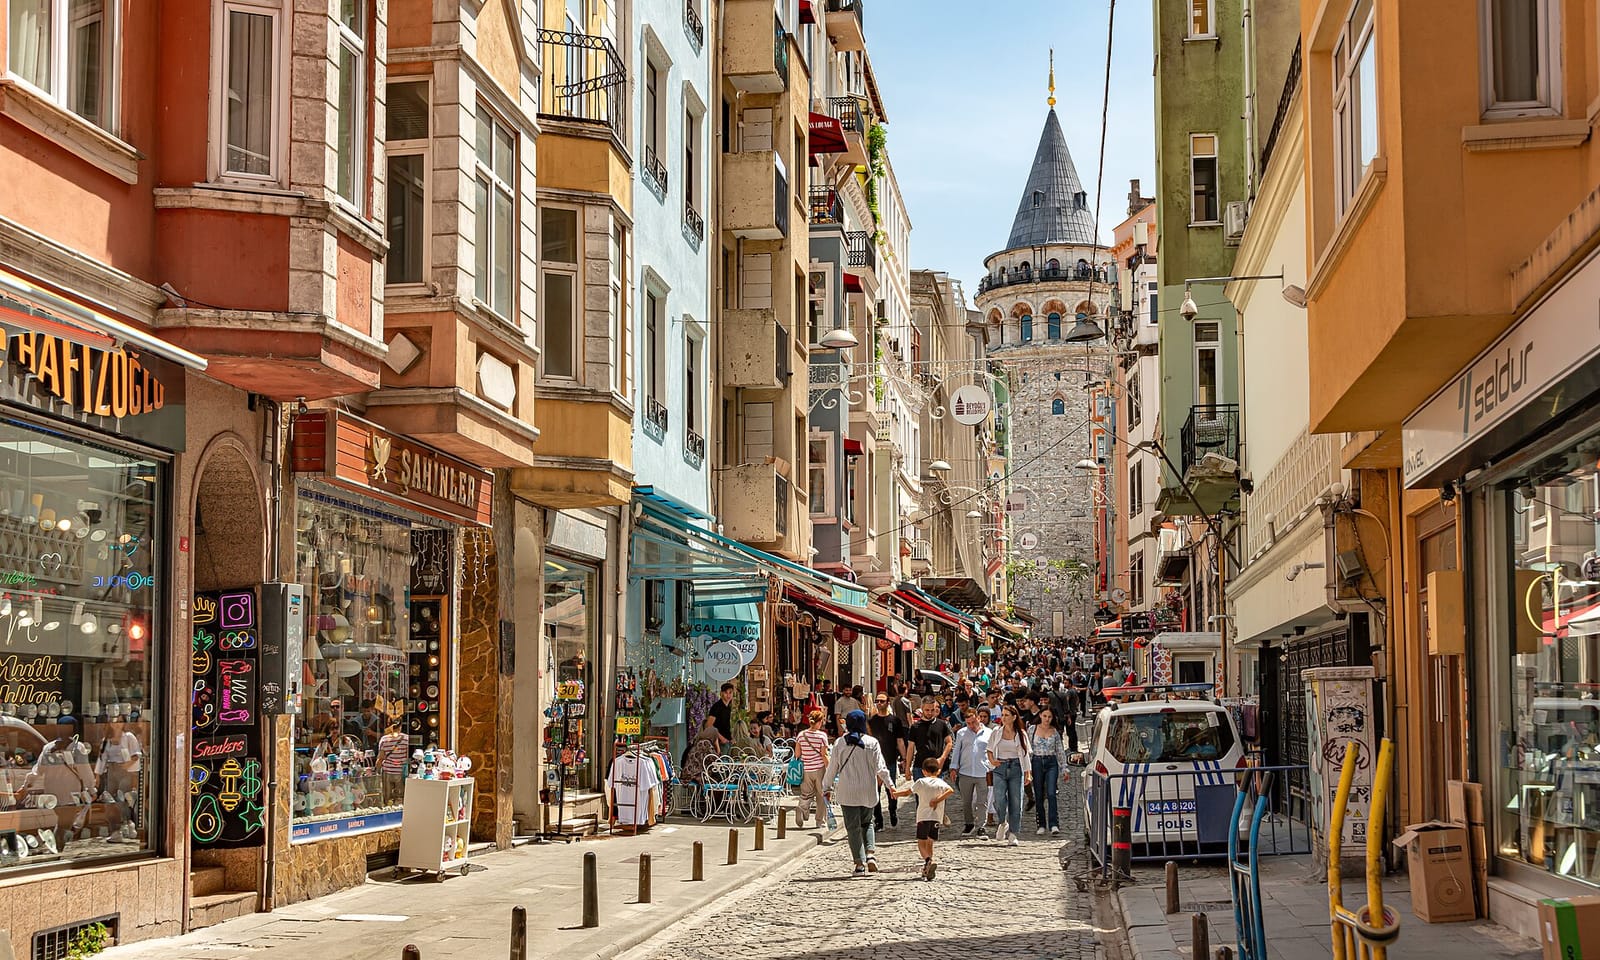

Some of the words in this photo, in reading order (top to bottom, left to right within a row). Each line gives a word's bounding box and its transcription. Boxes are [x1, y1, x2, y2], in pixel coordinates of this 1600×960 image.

[1474, 341, 1534, 422] seldur
[694, 624, 738, 634] GALATA
[708, 651, 738, 662] MOON
[232, 680, 248, 704] WC
[560, 685, 575, 696] 30
[193, 737, 244, 758] Sneakers
[1150, 803, 1161, 812] 34
[1163, 803, 1170, 811] A
